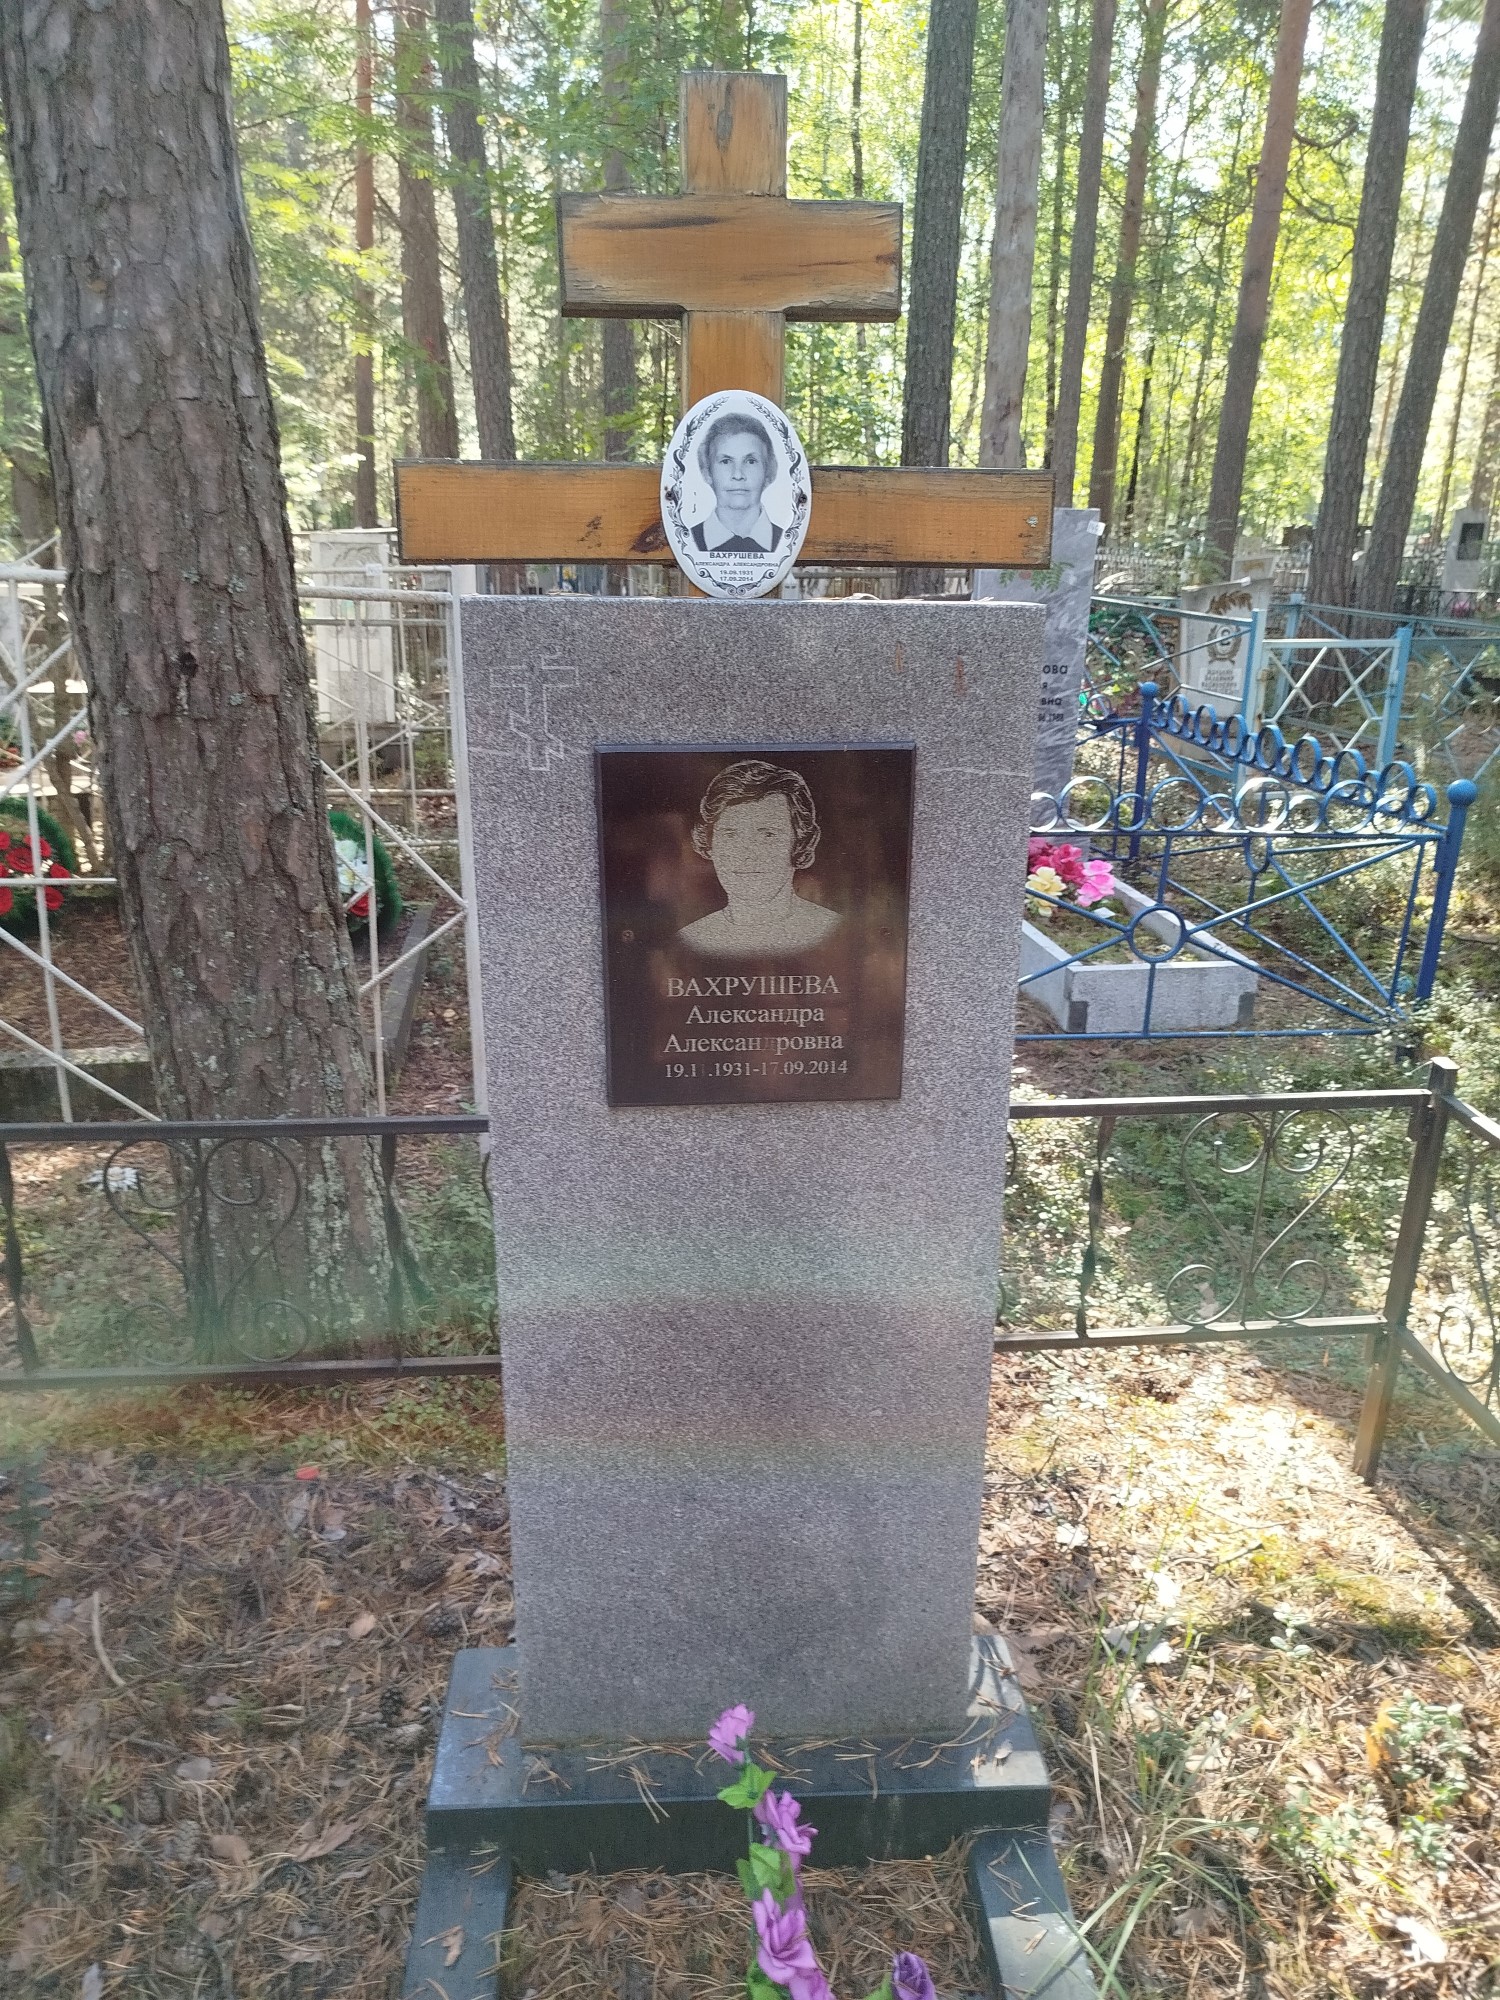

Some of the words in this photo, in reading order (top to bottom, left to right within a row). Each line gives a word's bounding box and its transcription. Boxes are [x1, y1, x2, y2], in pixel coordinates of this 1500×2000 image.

[709, 552, 765, 560] ВАХРУШЕВА
[666, 974, 841, 998] ВАХРУШЕВА
[685, 1004, 826, 1028] Александра
